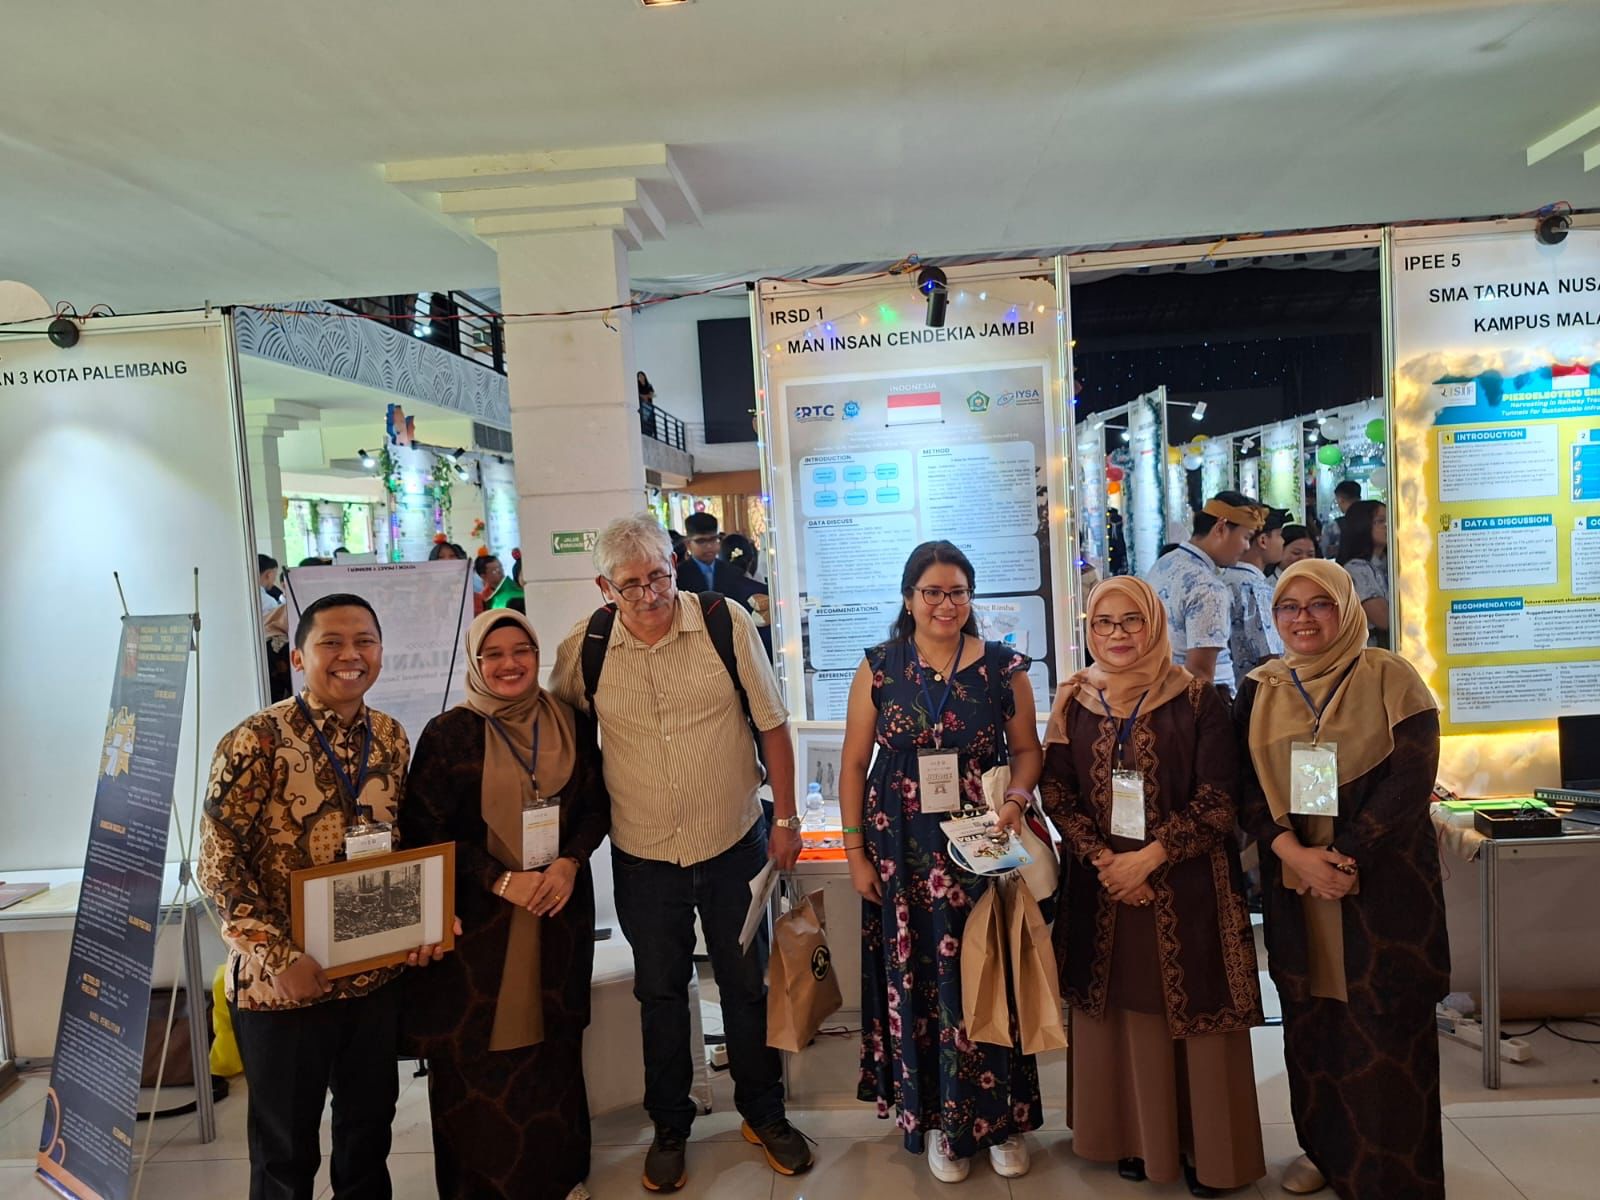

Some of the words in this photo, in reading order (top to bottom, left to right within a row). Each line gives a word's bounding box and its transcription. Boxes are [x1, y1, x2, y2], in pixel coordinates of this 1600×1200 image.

[1405, 254, 1445, 271] IPEE
[1451, 253, 1461, 268] 5
[1429, 286, 1469, 303] SMA
[1474, 281, 1550, 300] TARUNA
[1558, 277, 1600, 294] NUS
[770, 308, 810, 326] IRSD
[816, 306, 824, 321] 1
[1474, 313, 1550, 333] KAMPUS
[788, 338, 825, 354] MAN
[830, 333, 882, 351] INSAN
[887, 326, 976, 347] CENDEKIA
[979, 320, 1034, 338] JAMBI
[0, 371, 14, 386] N
[19, 371, 28, 385] 3
[33, 367, 79, 384] KOTA
[83, 360, 188, 380] PALEMBANG
[889, 382, 937, 392] INDONESIA
[1015, 389, 1040, 399] IYSA
[1457, 430, 1524, 441] INTRODUCTION
[804, 454, 852, 463] INTRODUCTION
[826, 518, 853, 526] DISCUSS
[1464, 519, 1488, 528] DATA
[1497, 515, 1550, 526] DISCUSSION
[816, 606, 879, 614] RECOMMENDATIONS
[1453, 600, 1521, 611] RECOMMENDATION
